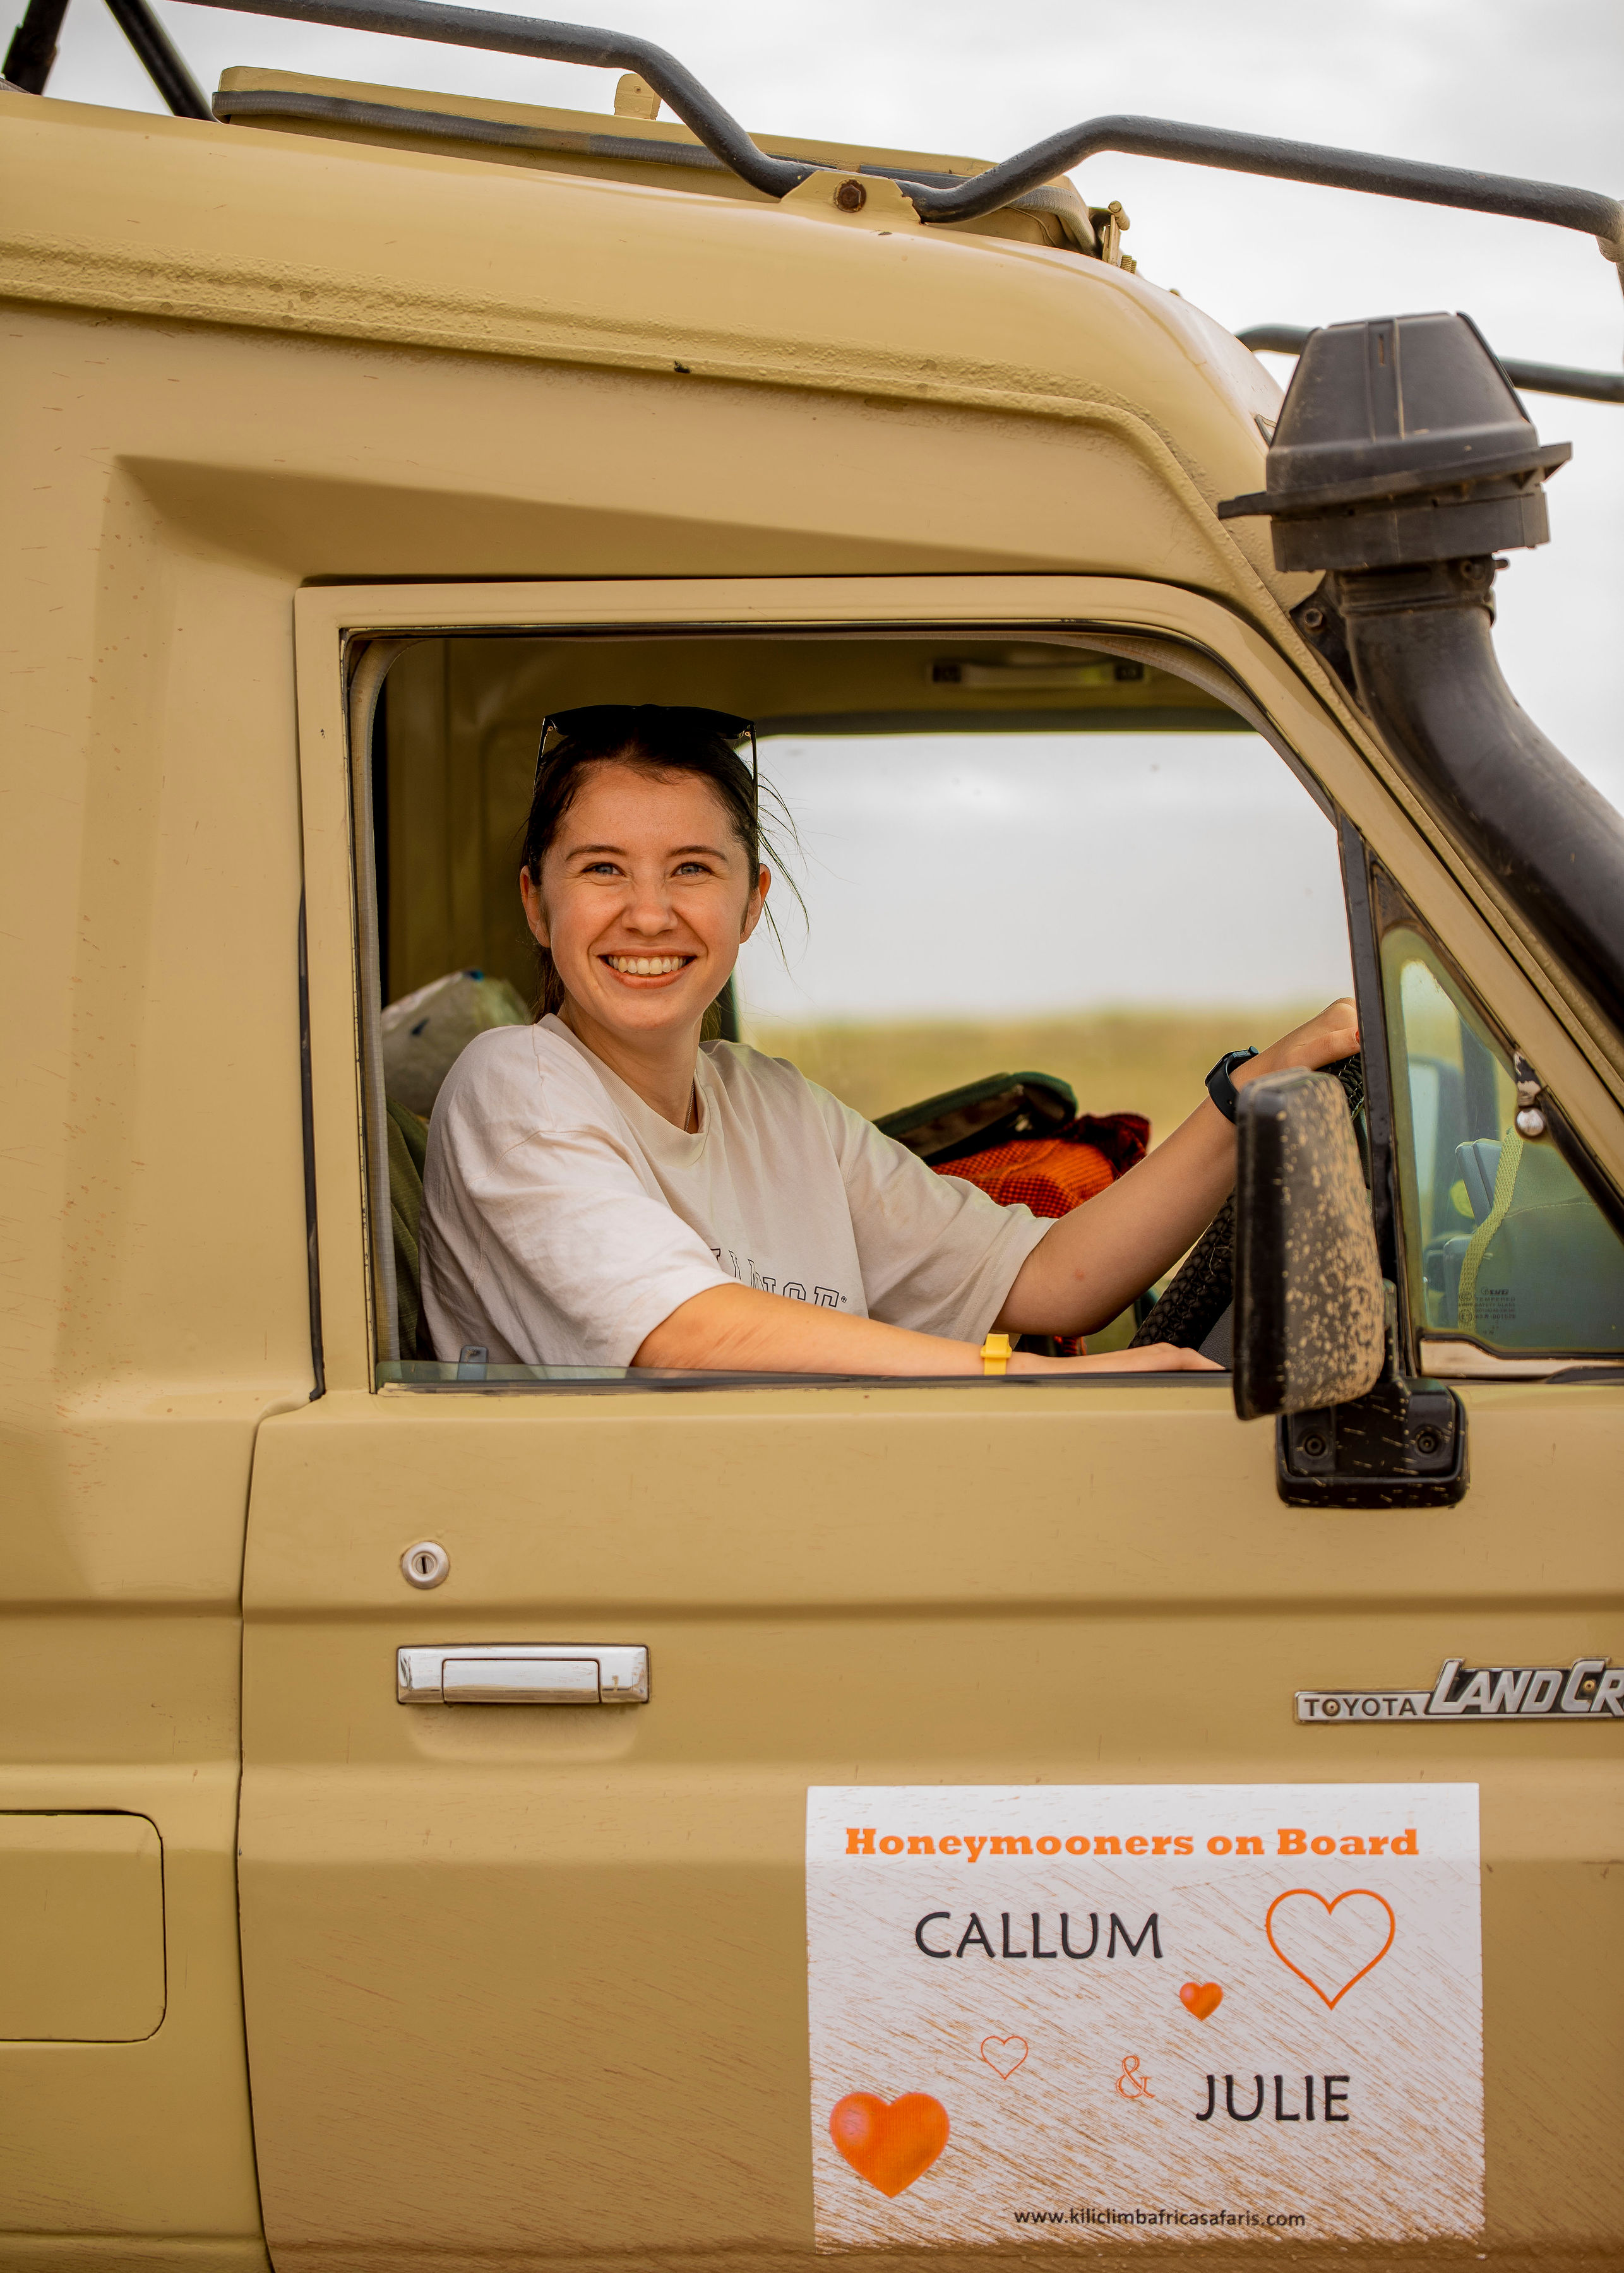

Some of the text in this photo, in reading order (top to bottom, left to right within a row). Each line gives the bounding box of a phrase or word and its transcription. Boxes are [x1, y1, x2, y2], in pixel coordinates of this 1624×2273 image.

[1304, 1697, 1418, 1717] TOYOTA
[845, 1827, 1419, 1863] Honeymooners on Board
[914, 1911, 1164, 1959] CALLUM
[1114, 2055, 1351, 2121] & JULIE
[1013, 2207, 1306, 2227] www.kiliclimbafricasafaris.com
